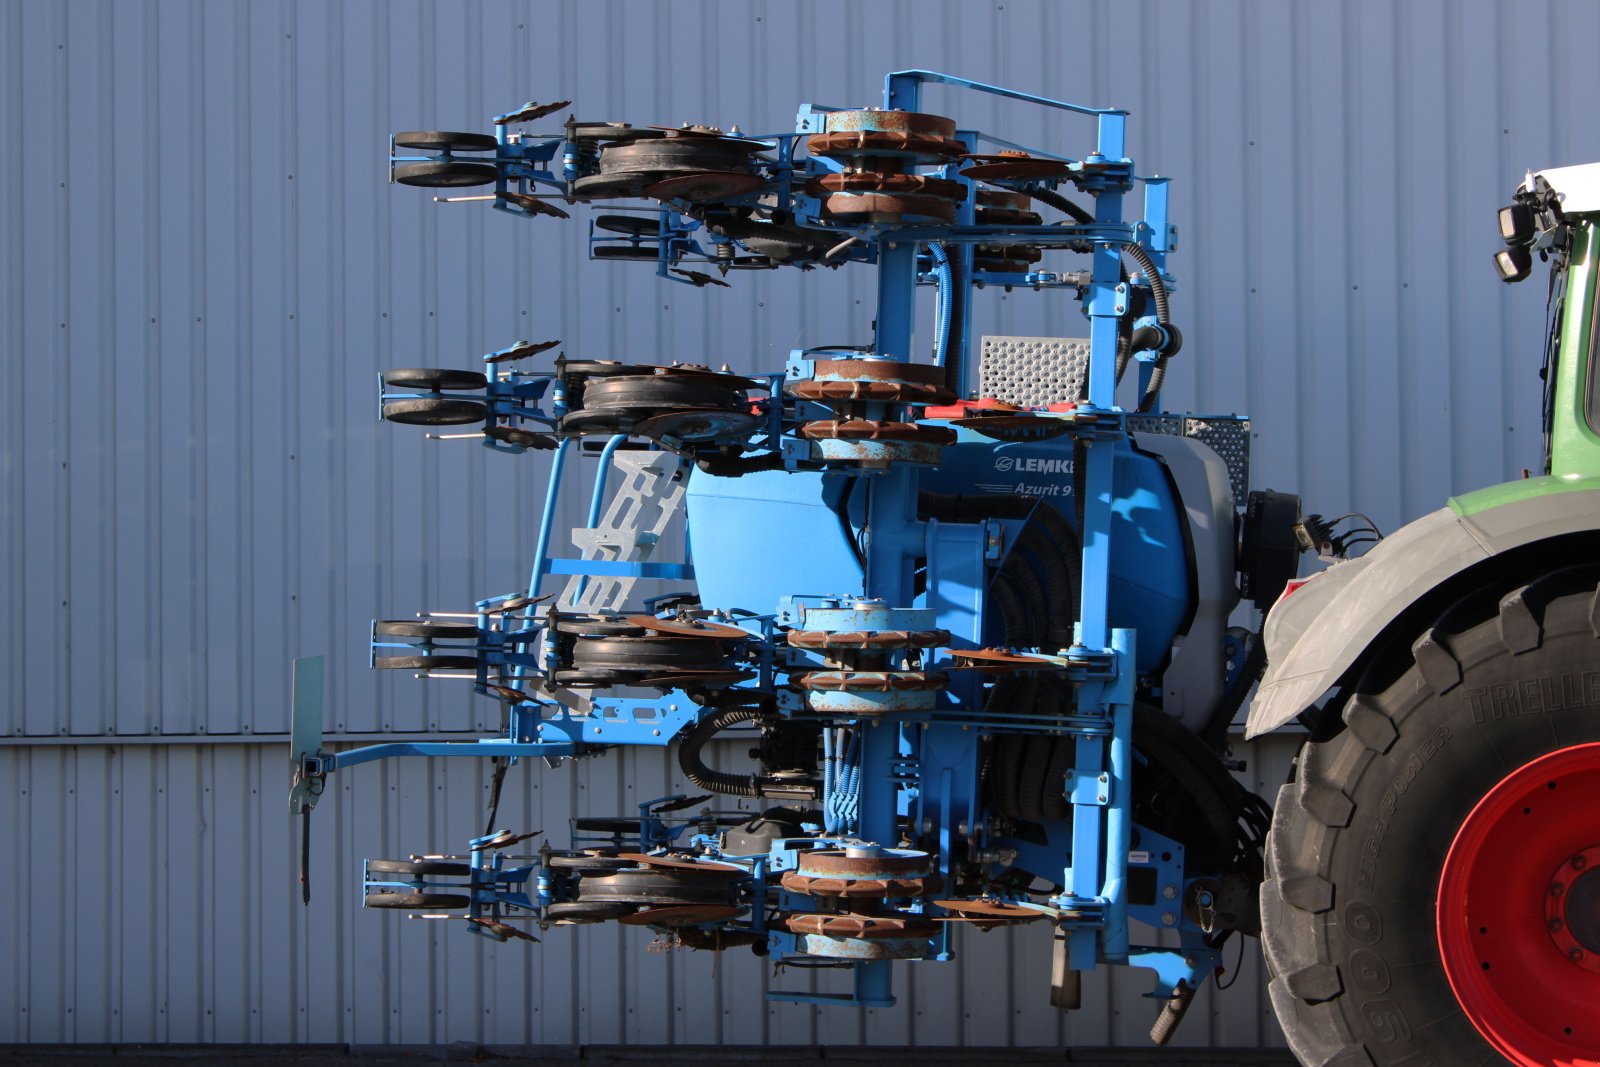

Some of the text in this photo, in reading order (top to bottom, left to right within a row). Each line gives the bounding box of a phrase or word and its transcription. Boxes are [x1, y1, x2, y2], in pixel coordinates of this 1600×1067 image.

[1014, 482, 1075, 497] Azurit 9
[1343, 725, 1454, 1067] 900 HIGH POWER
